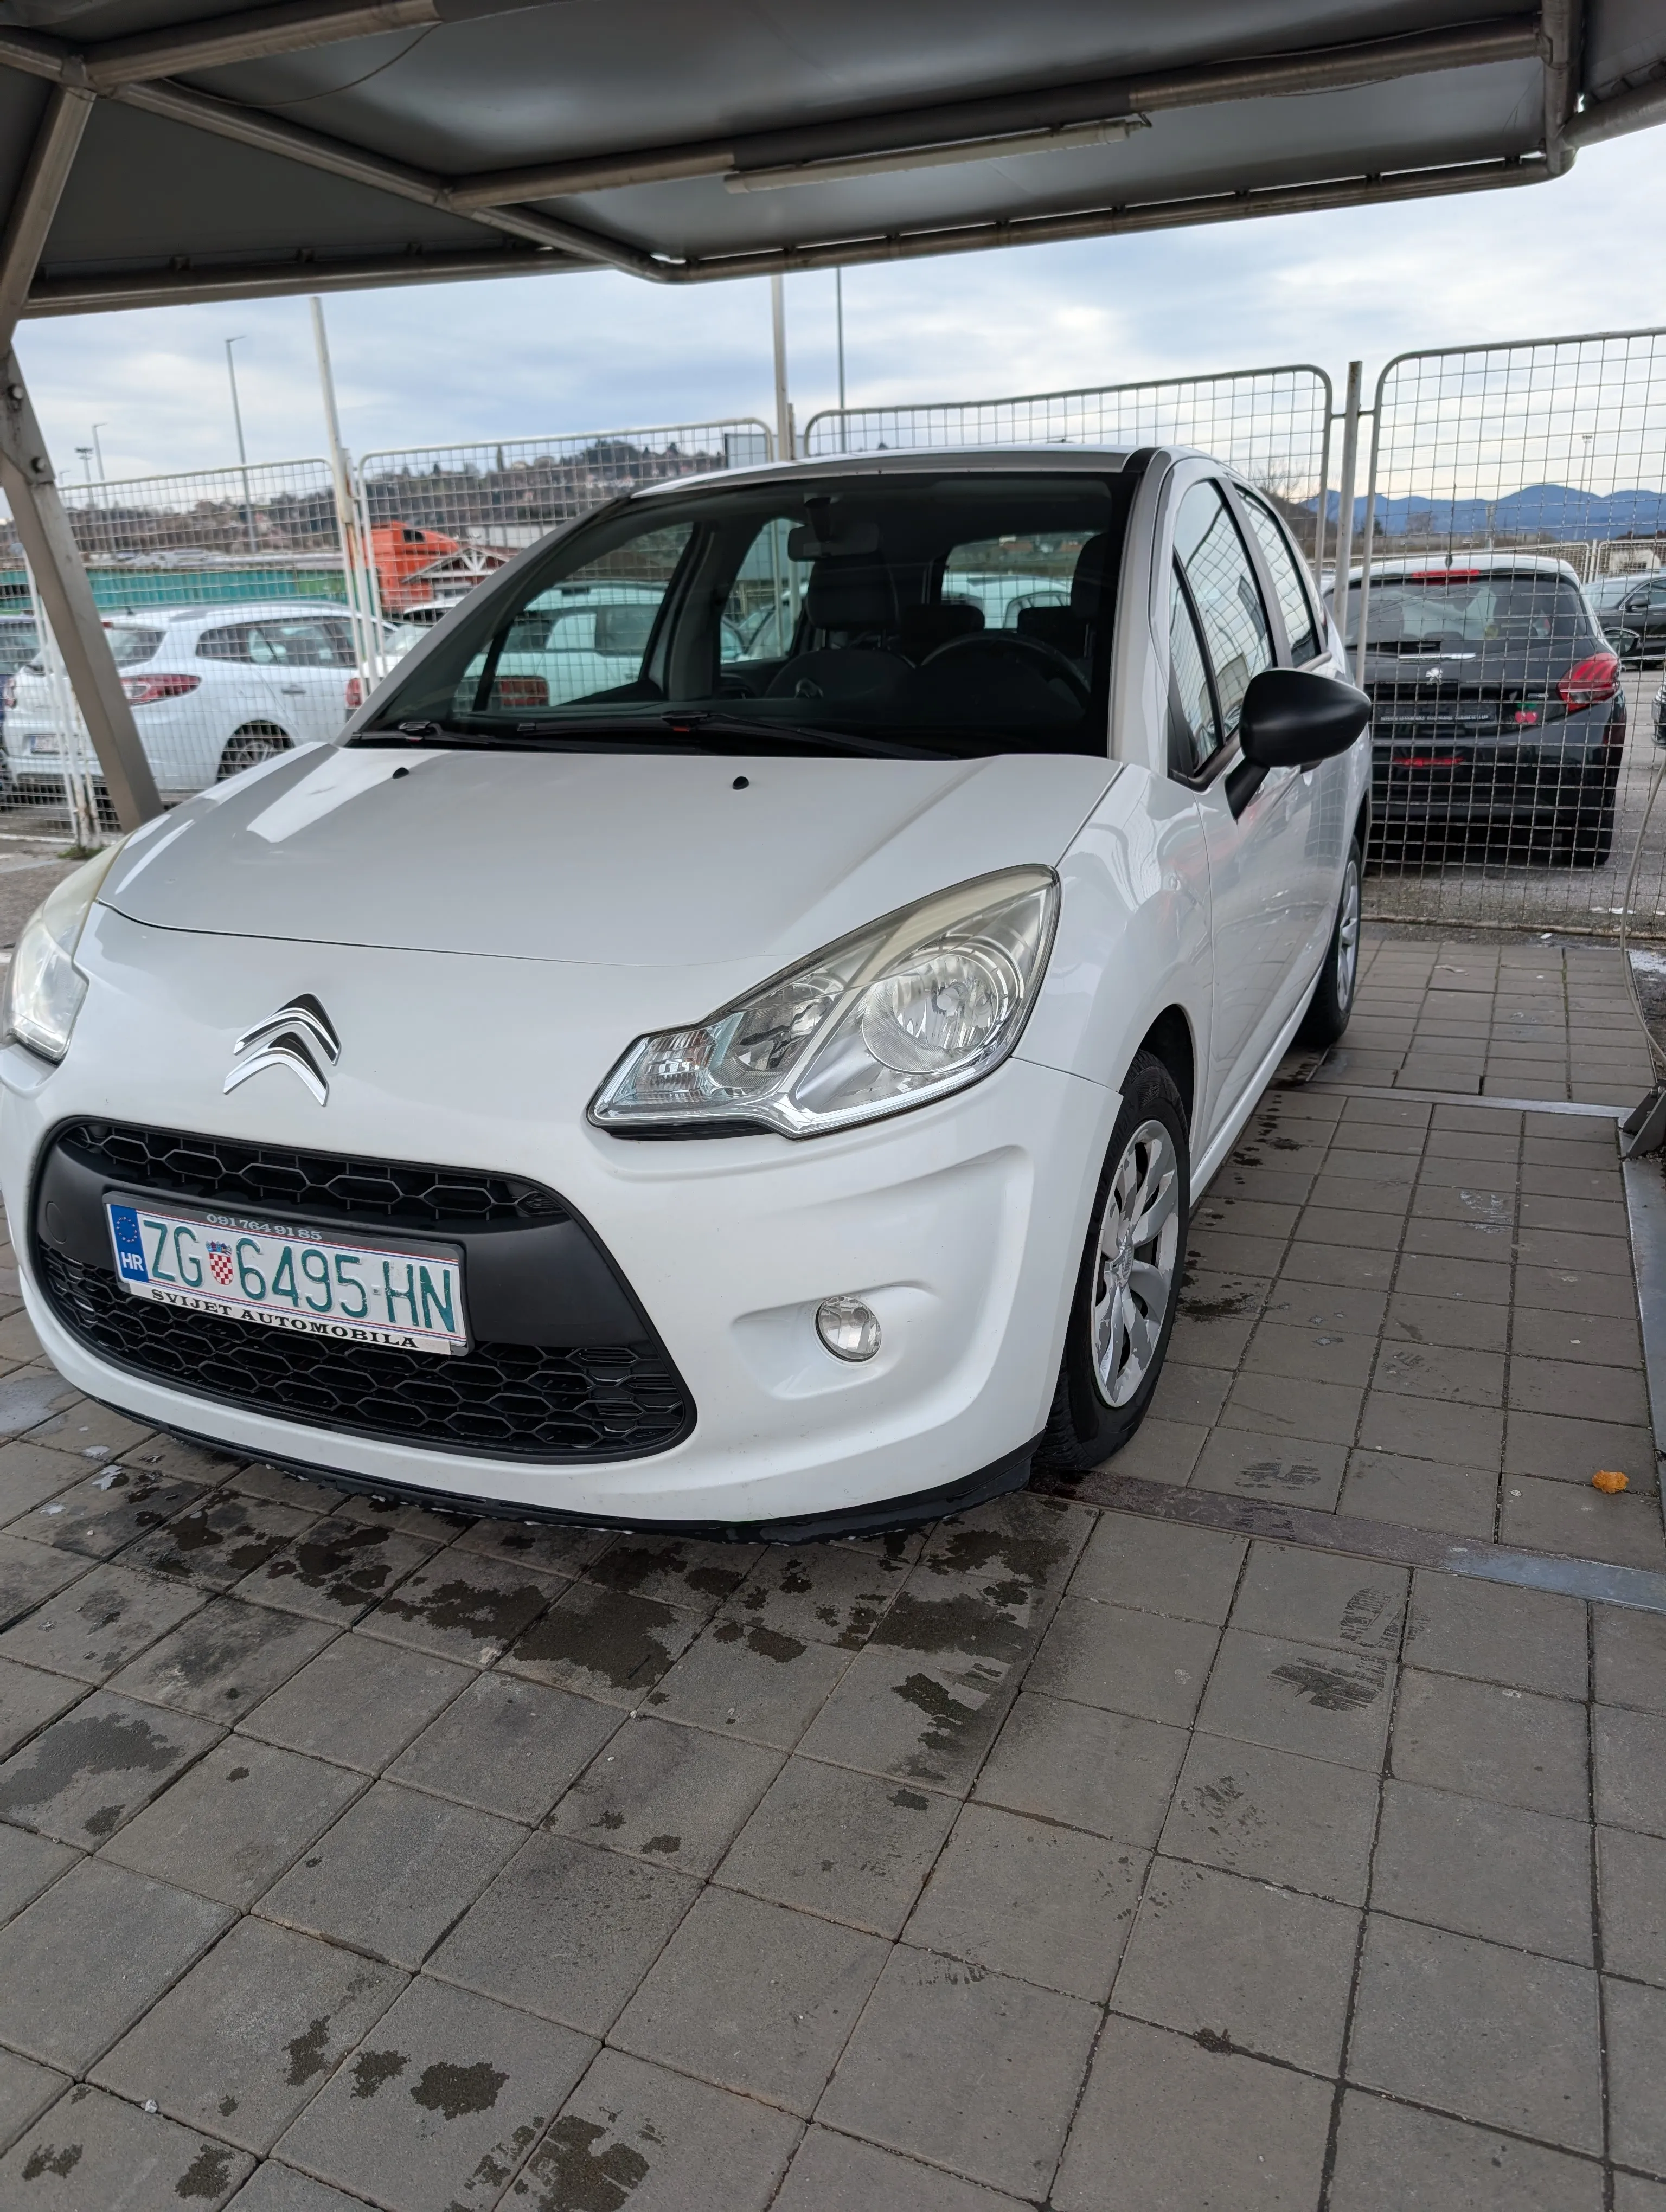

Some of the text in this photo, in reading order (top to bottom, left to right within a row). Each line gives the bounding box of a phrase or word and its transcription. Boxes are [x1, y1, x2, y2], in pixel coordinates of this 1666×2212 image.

[206, 1213, 322, 1240] 091 764 91 85
[121, 1251, 144, 1271] HR
[143, 1219, 203, 1288] ZG
[151, 1288, 421, 1349] SVIJET AUTOMOBILA
